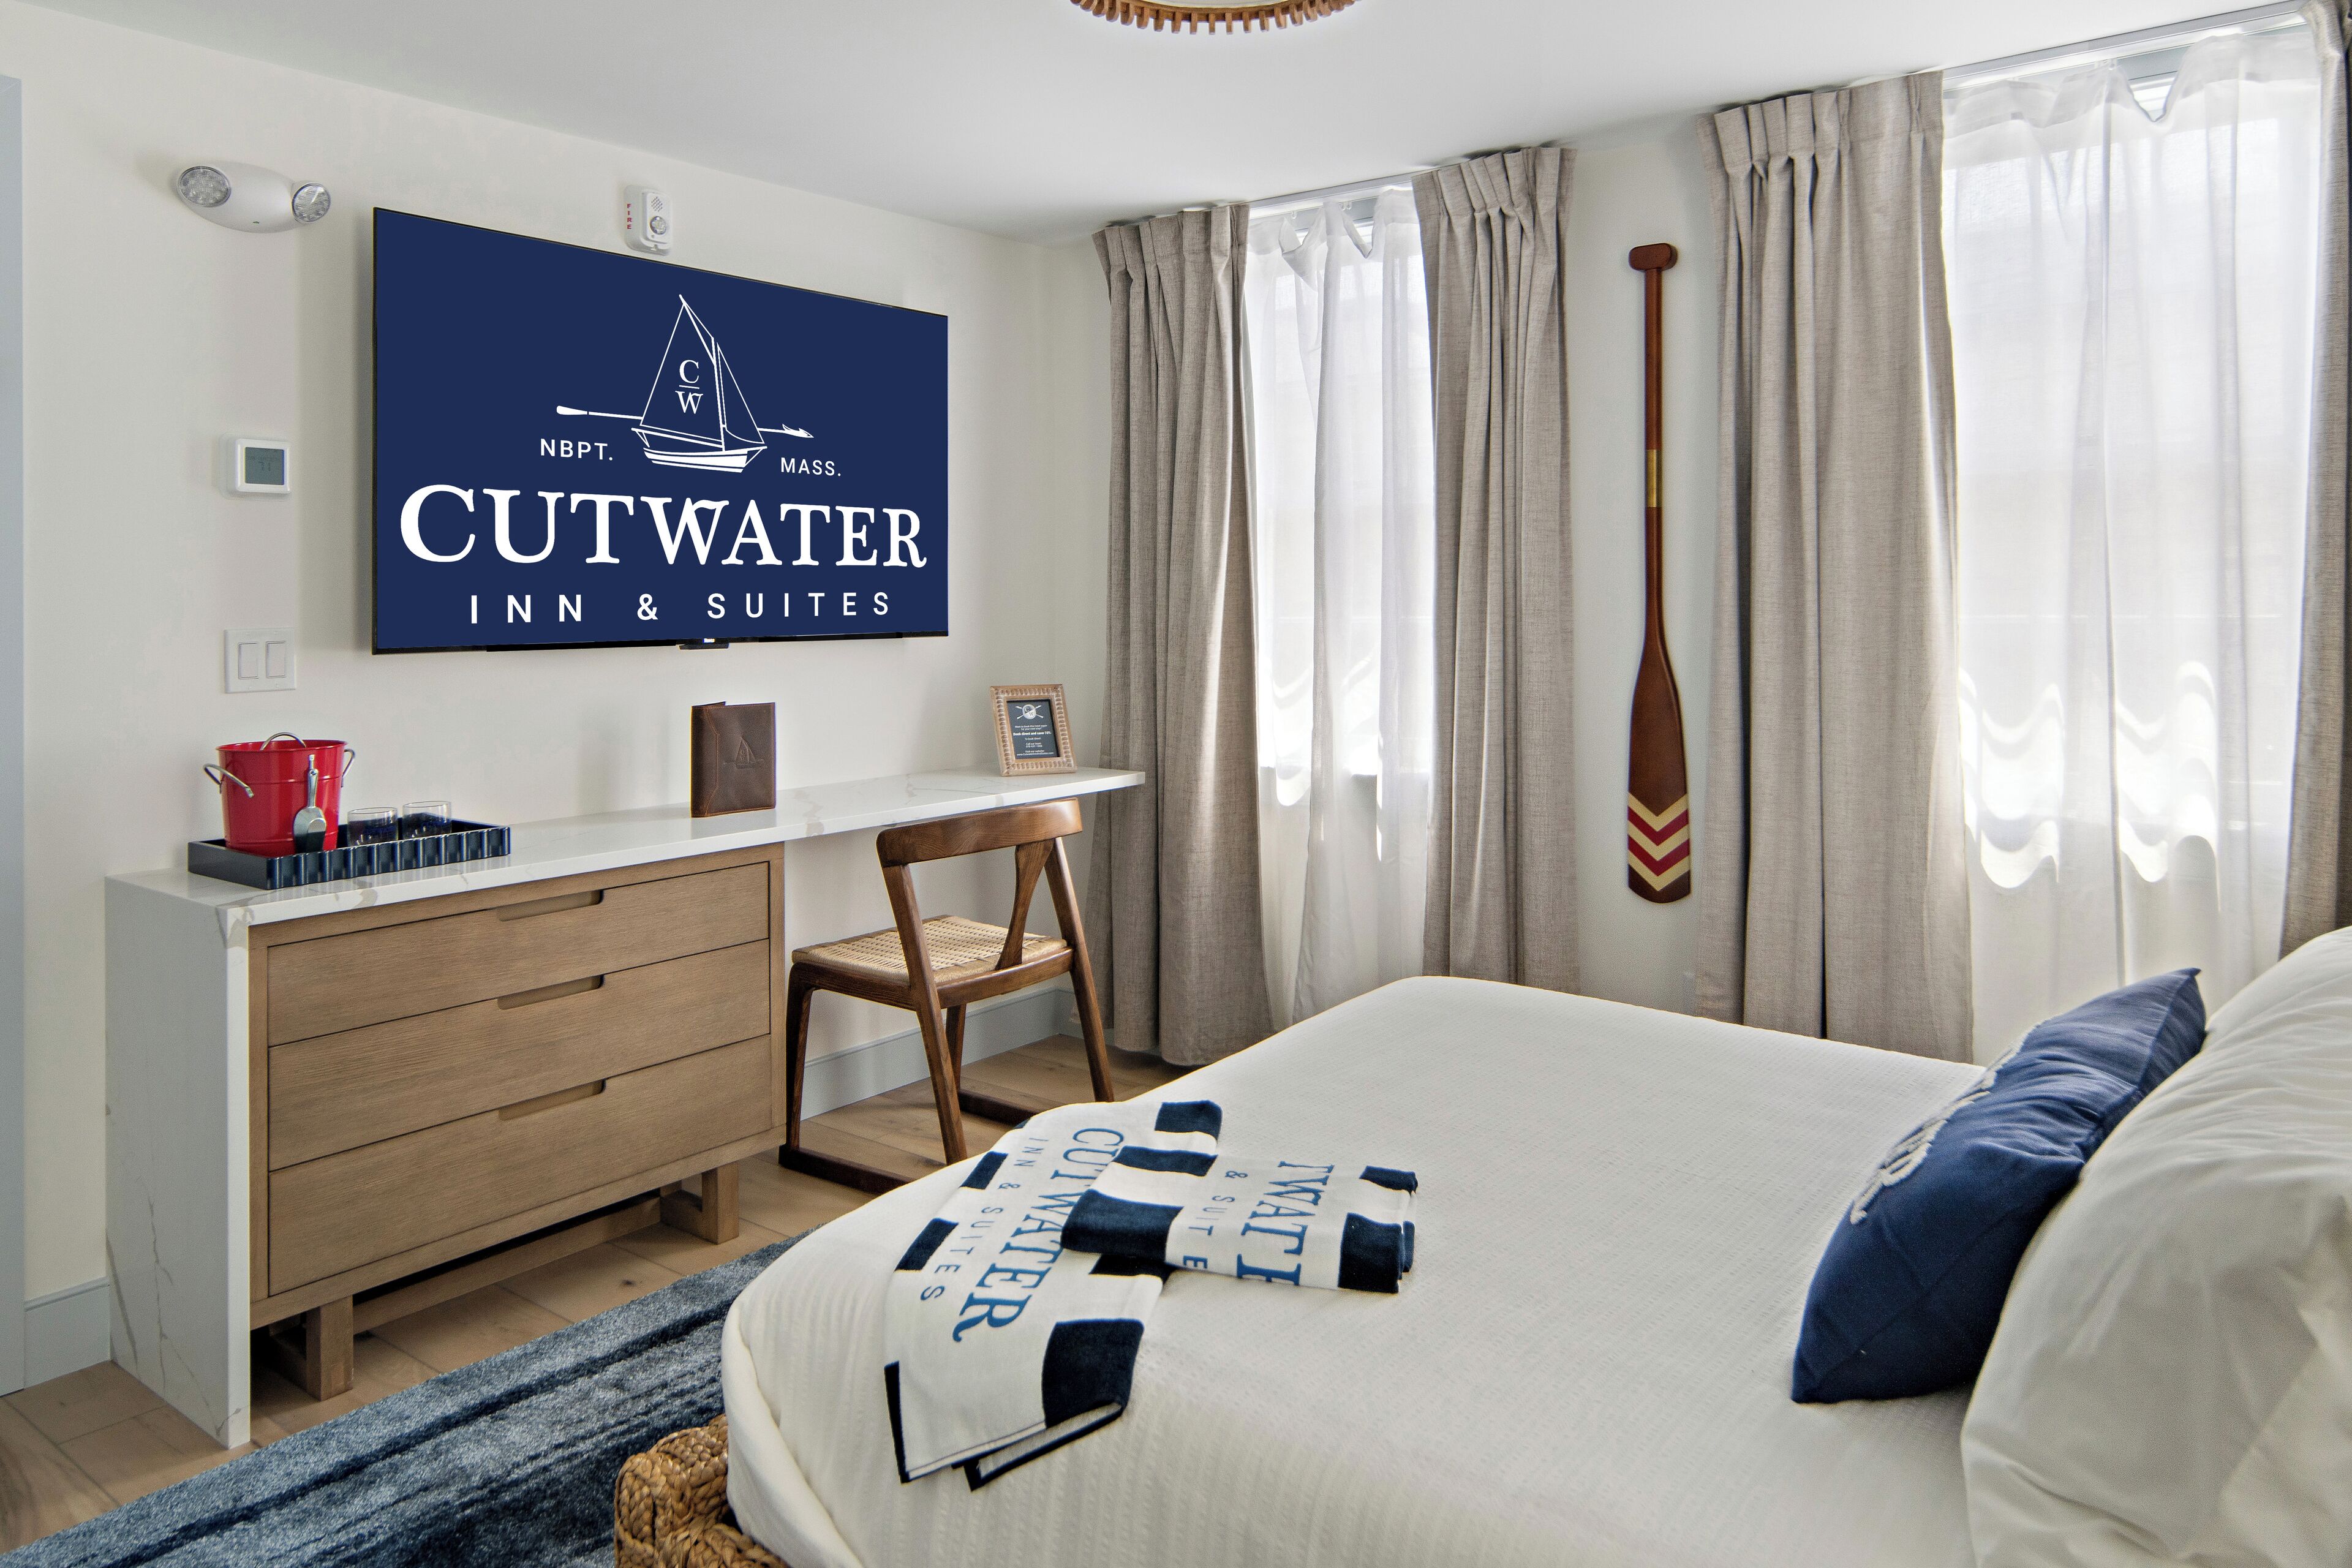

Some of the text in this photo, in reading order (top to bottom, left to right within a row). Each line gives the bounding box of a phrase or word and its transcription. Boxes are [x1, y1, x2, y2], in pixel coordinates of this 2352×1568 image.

[679, 360, 699, 383] C
[674, 390, 704, 415] W
[540, 438, 613, 461] NBPT.
[781, 457, 842, 478] MASS.
[400, 484, 927, 568] CUTWATER
[471, 592, 888, 624] INN & SUITES
[1224, 1170, 1249, 1180] &
[919, 1137, 1049, 1302] INN & SUITES
[952, 1127, 1125, 1343] CUTWATER
